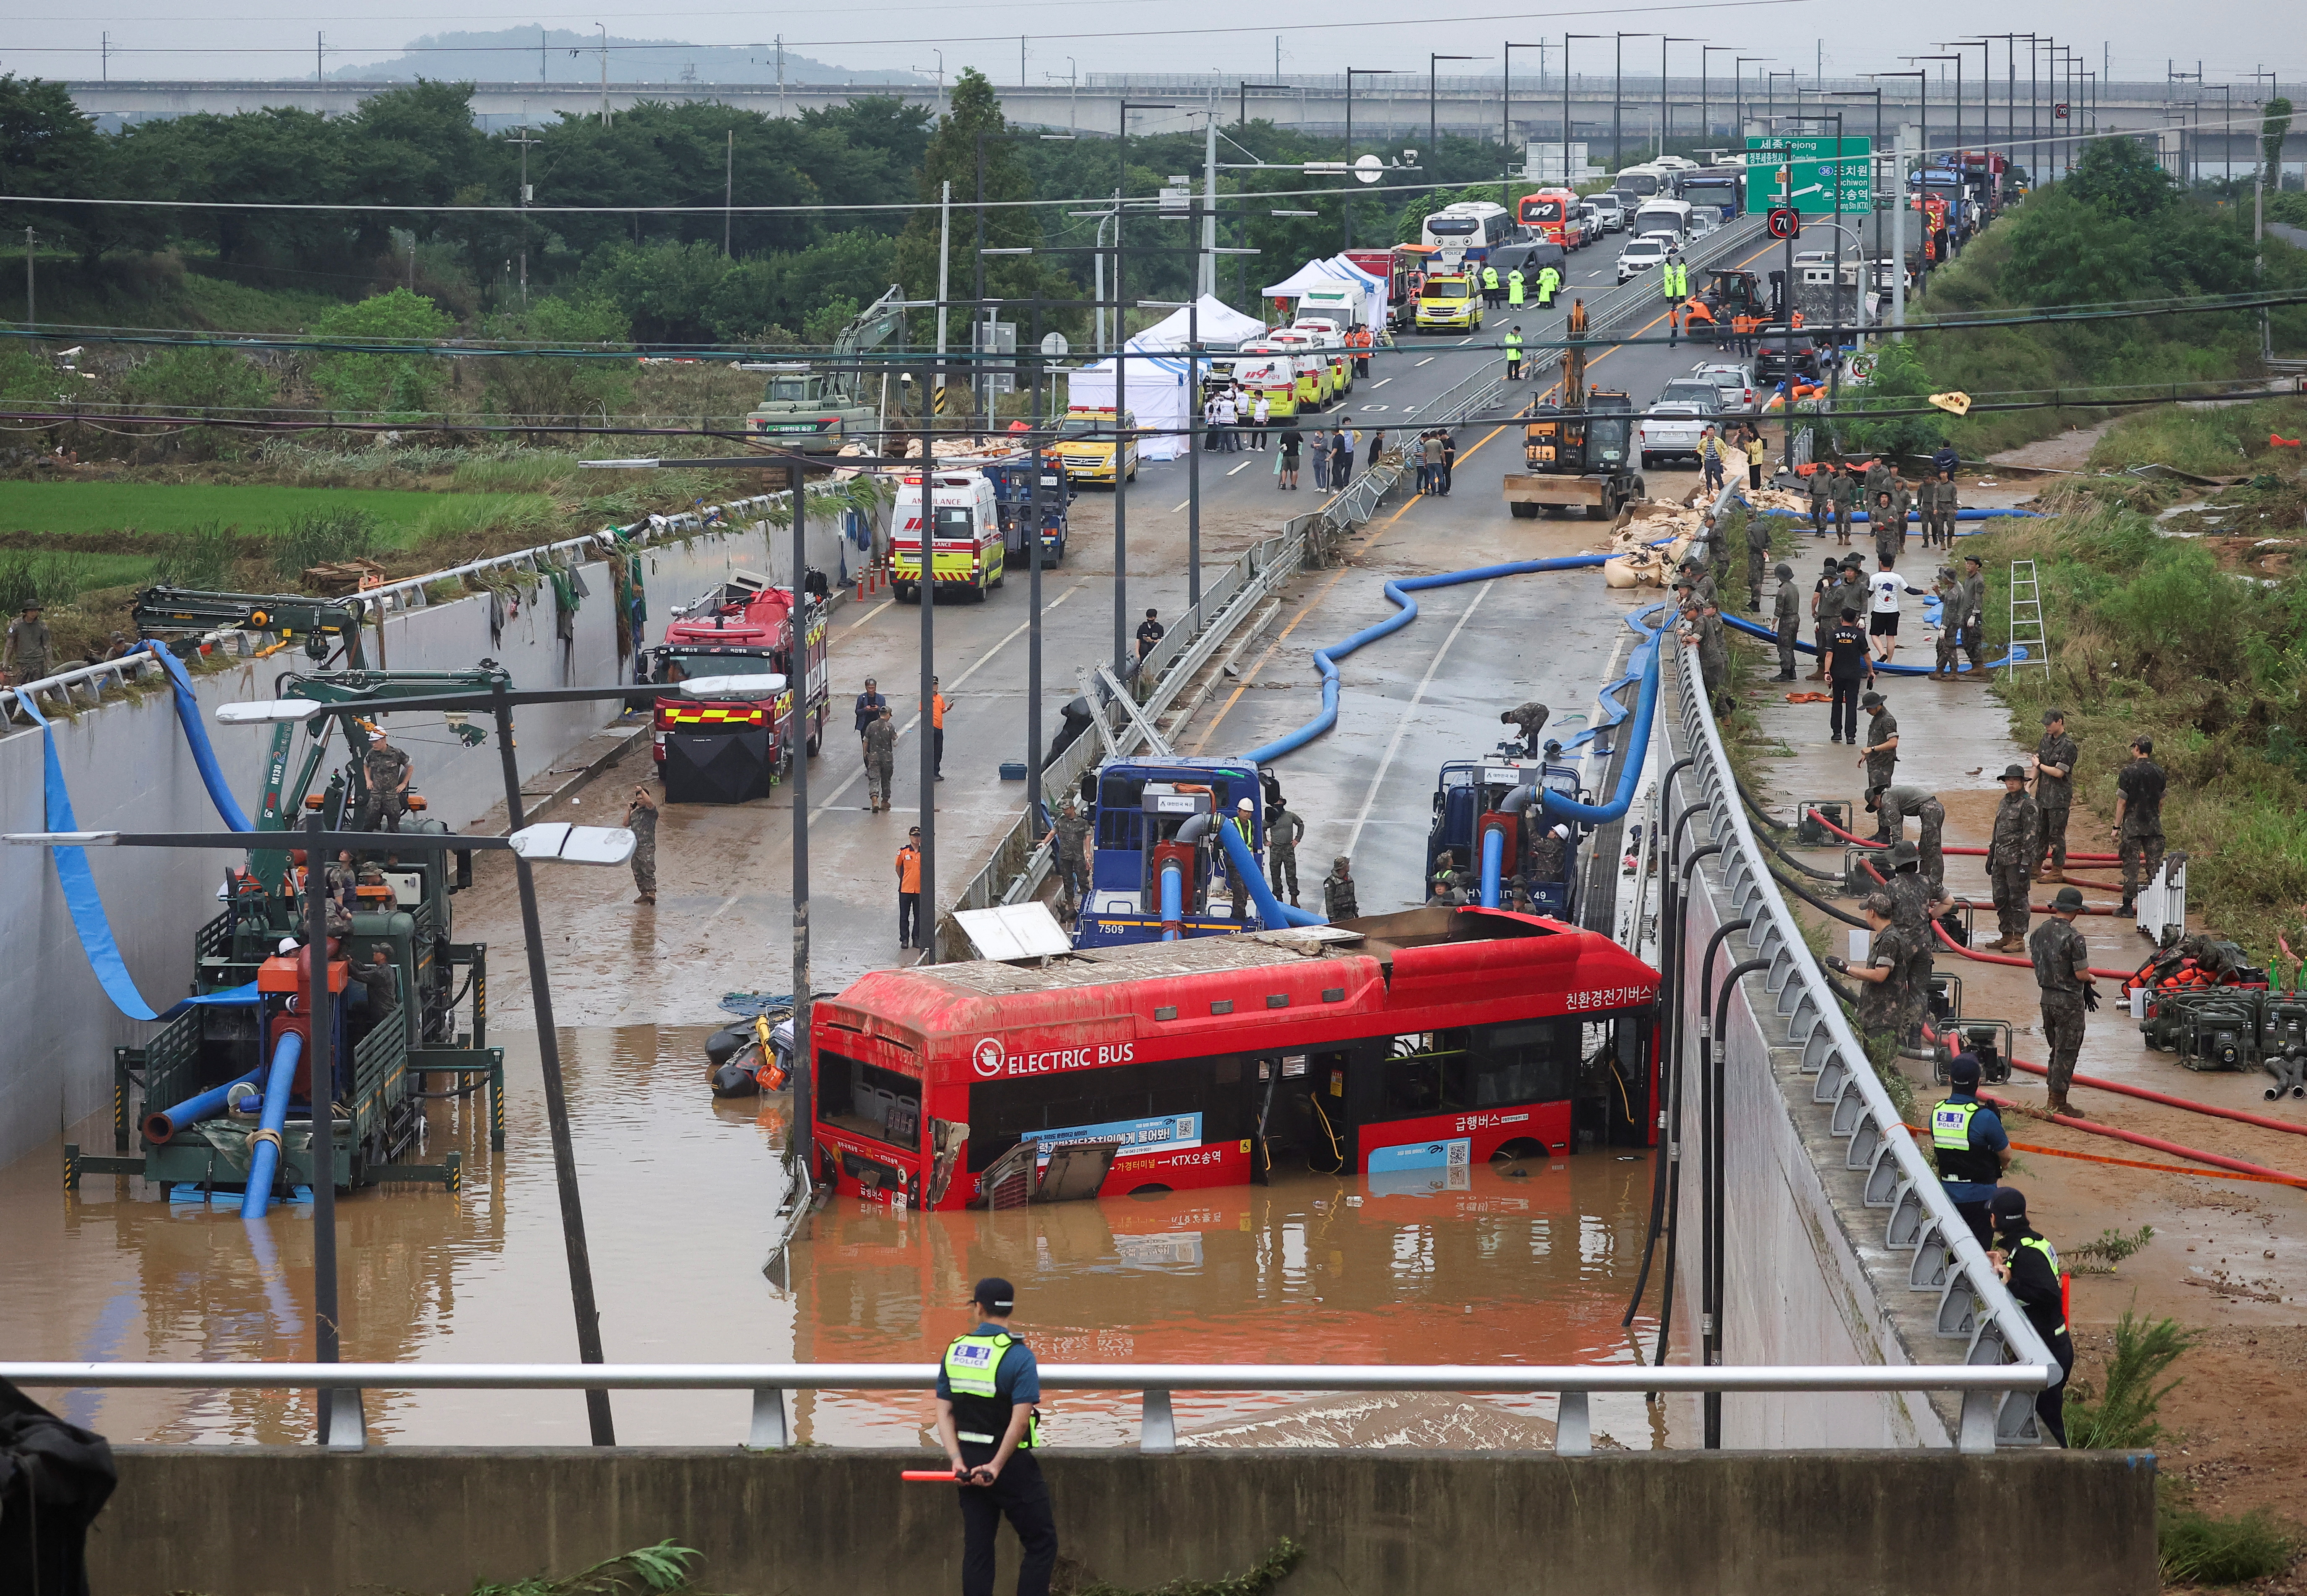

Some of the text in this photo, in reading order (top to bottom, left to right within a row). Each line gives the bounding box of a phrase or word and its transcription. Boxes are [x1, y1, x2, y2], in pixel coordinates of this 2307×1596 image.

[1760, 139, 1783, 149] 세종
[1833, 165, 1868, 177] 조치원
[1528, 204, 1554, 216] 119
[1244, 369, 1269, 379] 119
[1835, 632, 1857, 640] 과학수사
[271, 764, 282, 785] M130
[1534, 891, 1547, 900] 49
[1098, 924, 1124, 934] 7509
[1566, 985, 1652, 1010] 친환경전기버스
[1008, 1043, 1133, 1075] ELECTRIC BUS
[1455, 1114, 1500, 1132] 급행버스
[1138, 1127, 1171, 1144] 물어봐!
[837, 1141, 858, 1153] 청주국제공항
[880, 1154, 898, 1166] KTX오송역
[1117, 1150, 1221, 1172] 가경터미널 KTX오송역
[898, 1195, 906, 1207] 주의
[953, 1357, 984, 1366] POLICE
